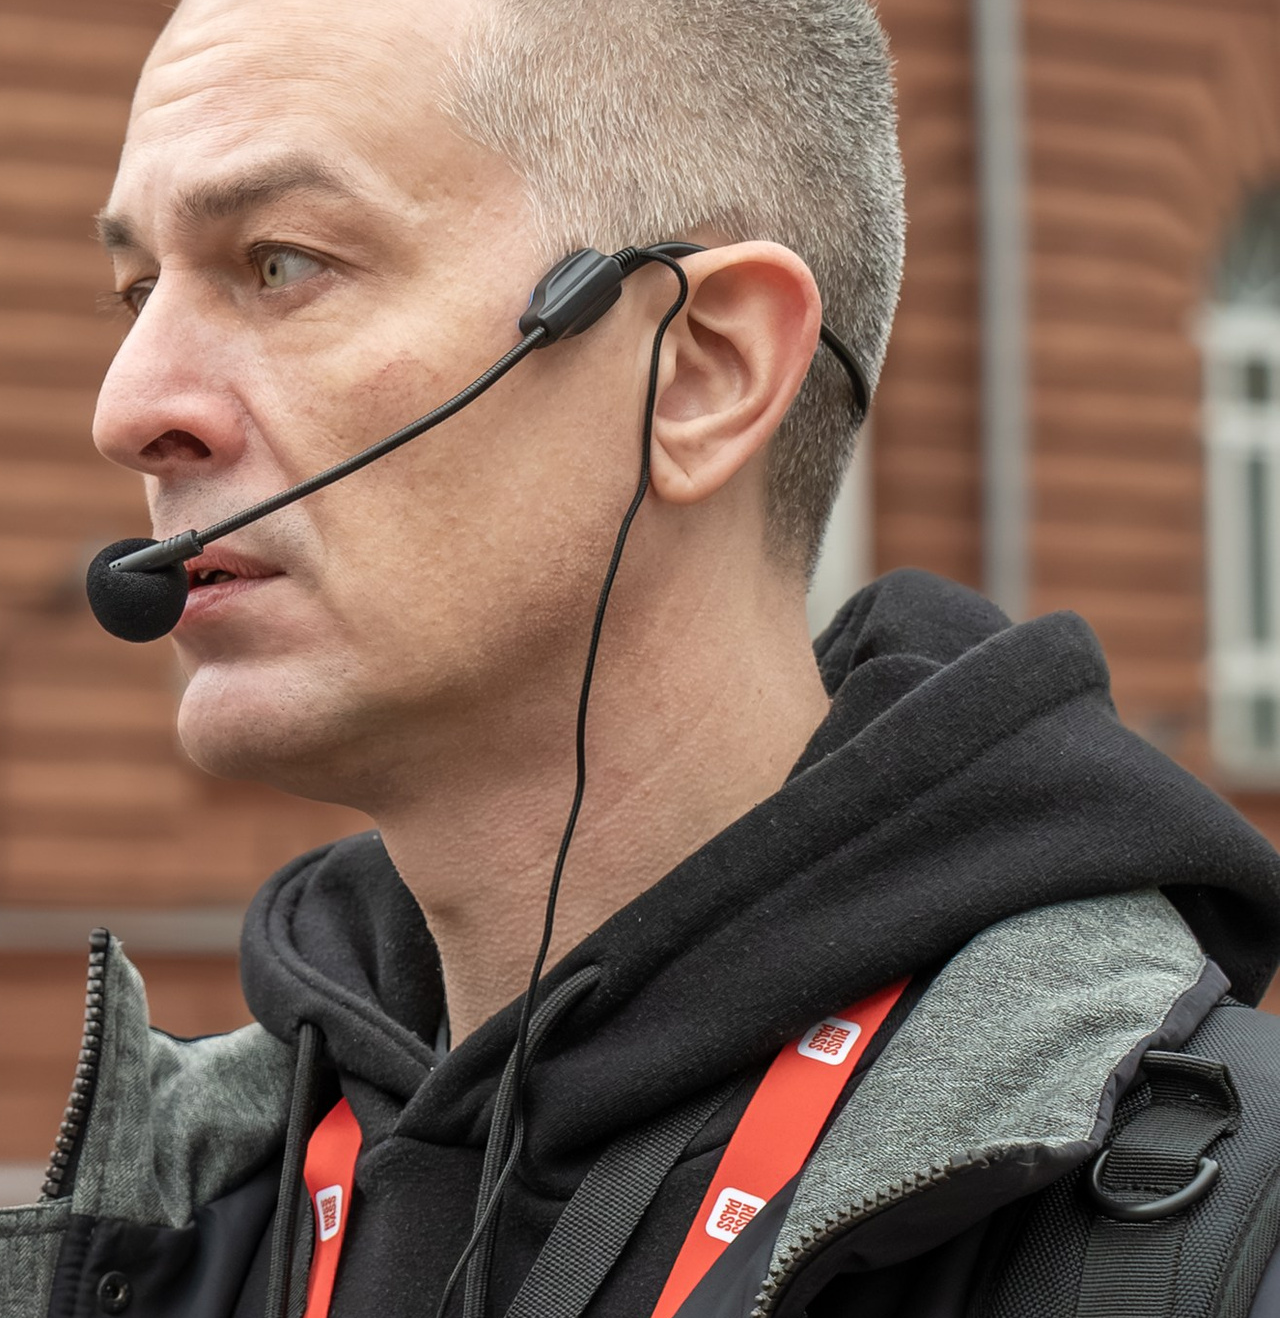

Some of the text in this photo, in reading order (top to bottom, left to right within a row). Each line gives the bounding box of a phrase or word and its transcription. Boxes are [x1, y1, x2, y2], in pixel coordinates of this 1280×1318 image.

[808, 1023, 836, 1051] PASS
[823, 1027, 851, 1056] RUSS
[716, 1197, 742, 1232] PASS
